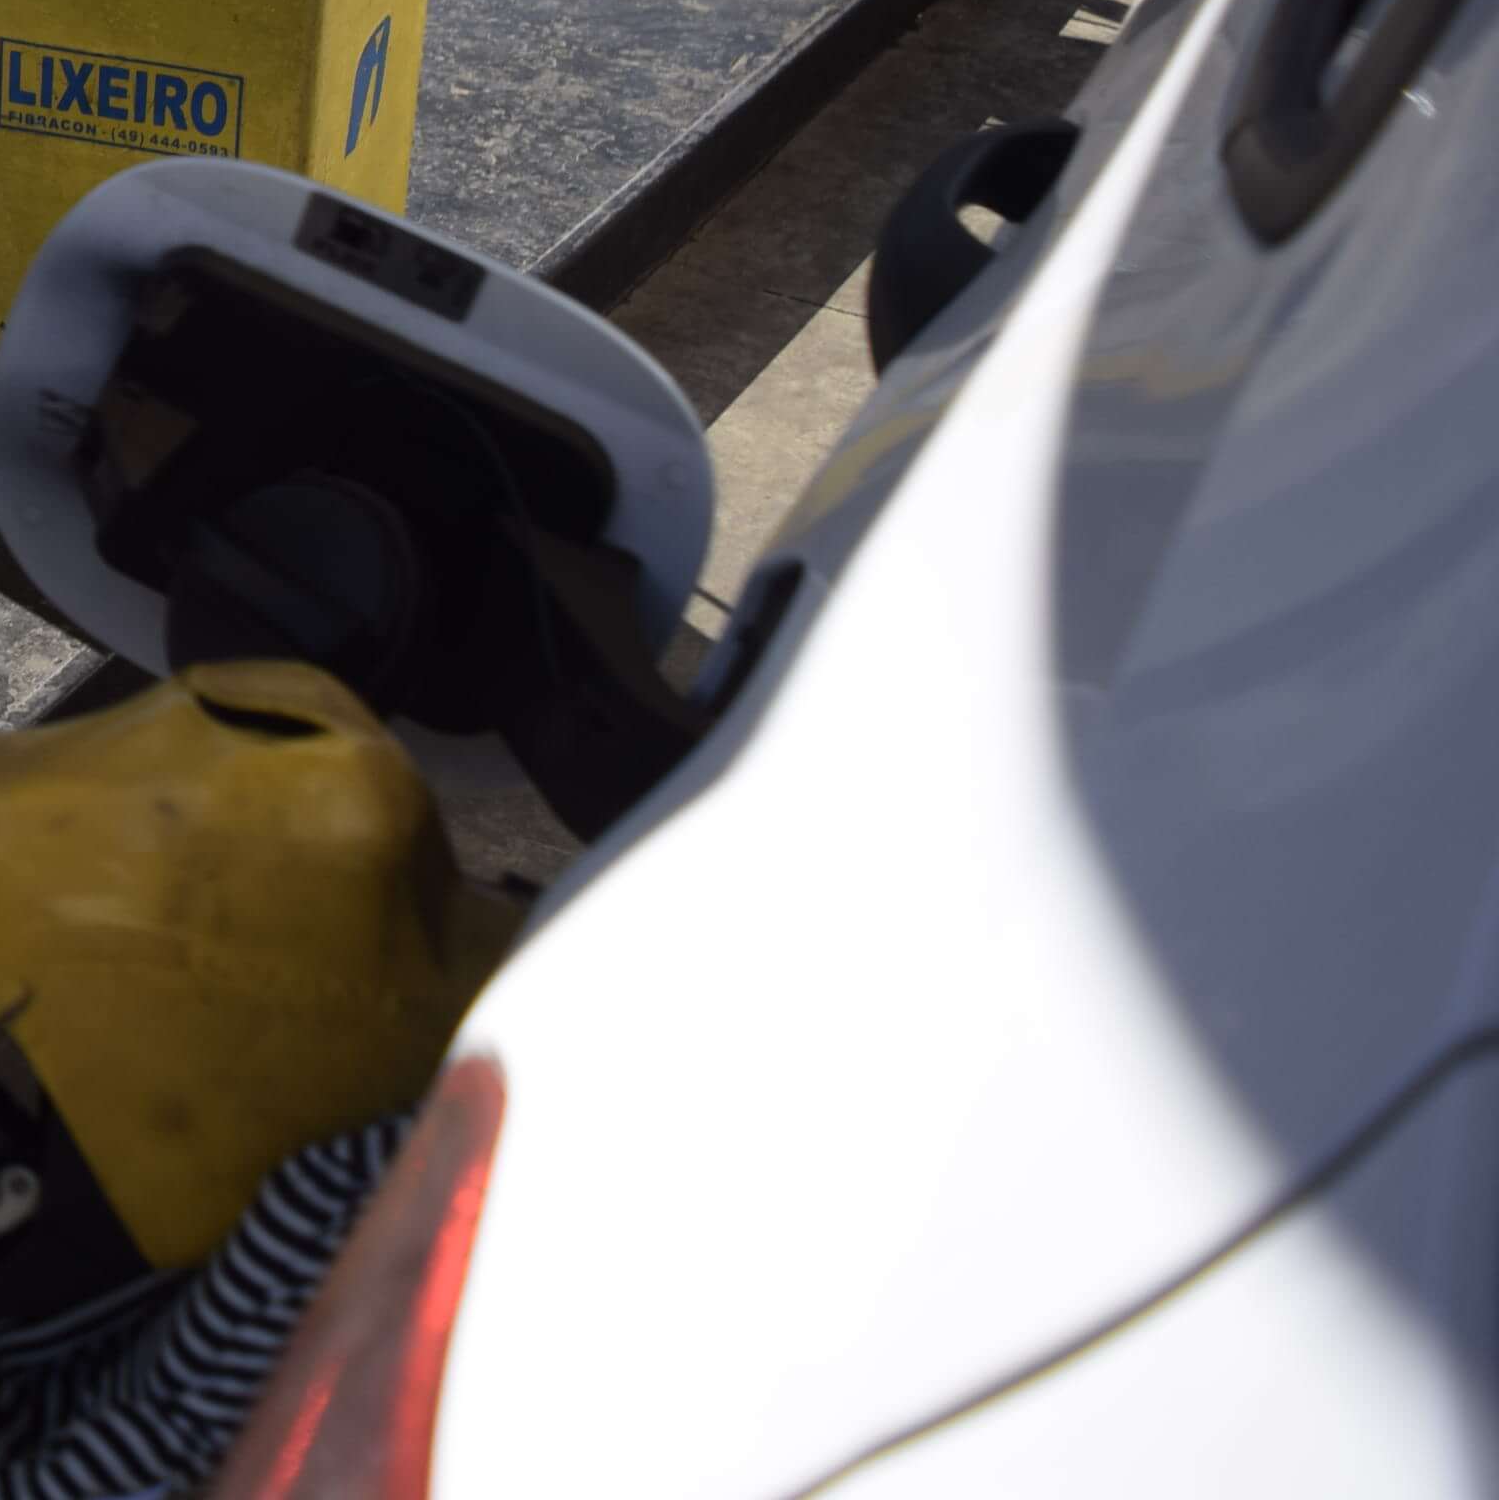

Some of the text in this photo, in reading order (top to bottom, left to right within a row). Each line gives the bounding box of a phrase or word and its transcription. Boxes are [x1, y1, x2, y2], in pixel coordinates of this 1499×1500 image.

[8, 50, 228, 137] LIXEIRO
[8, 110, 97, 135] FIBRACON
[111, 127, 145, 148] (49)
[150, 134, 229, 158] 444-0593
